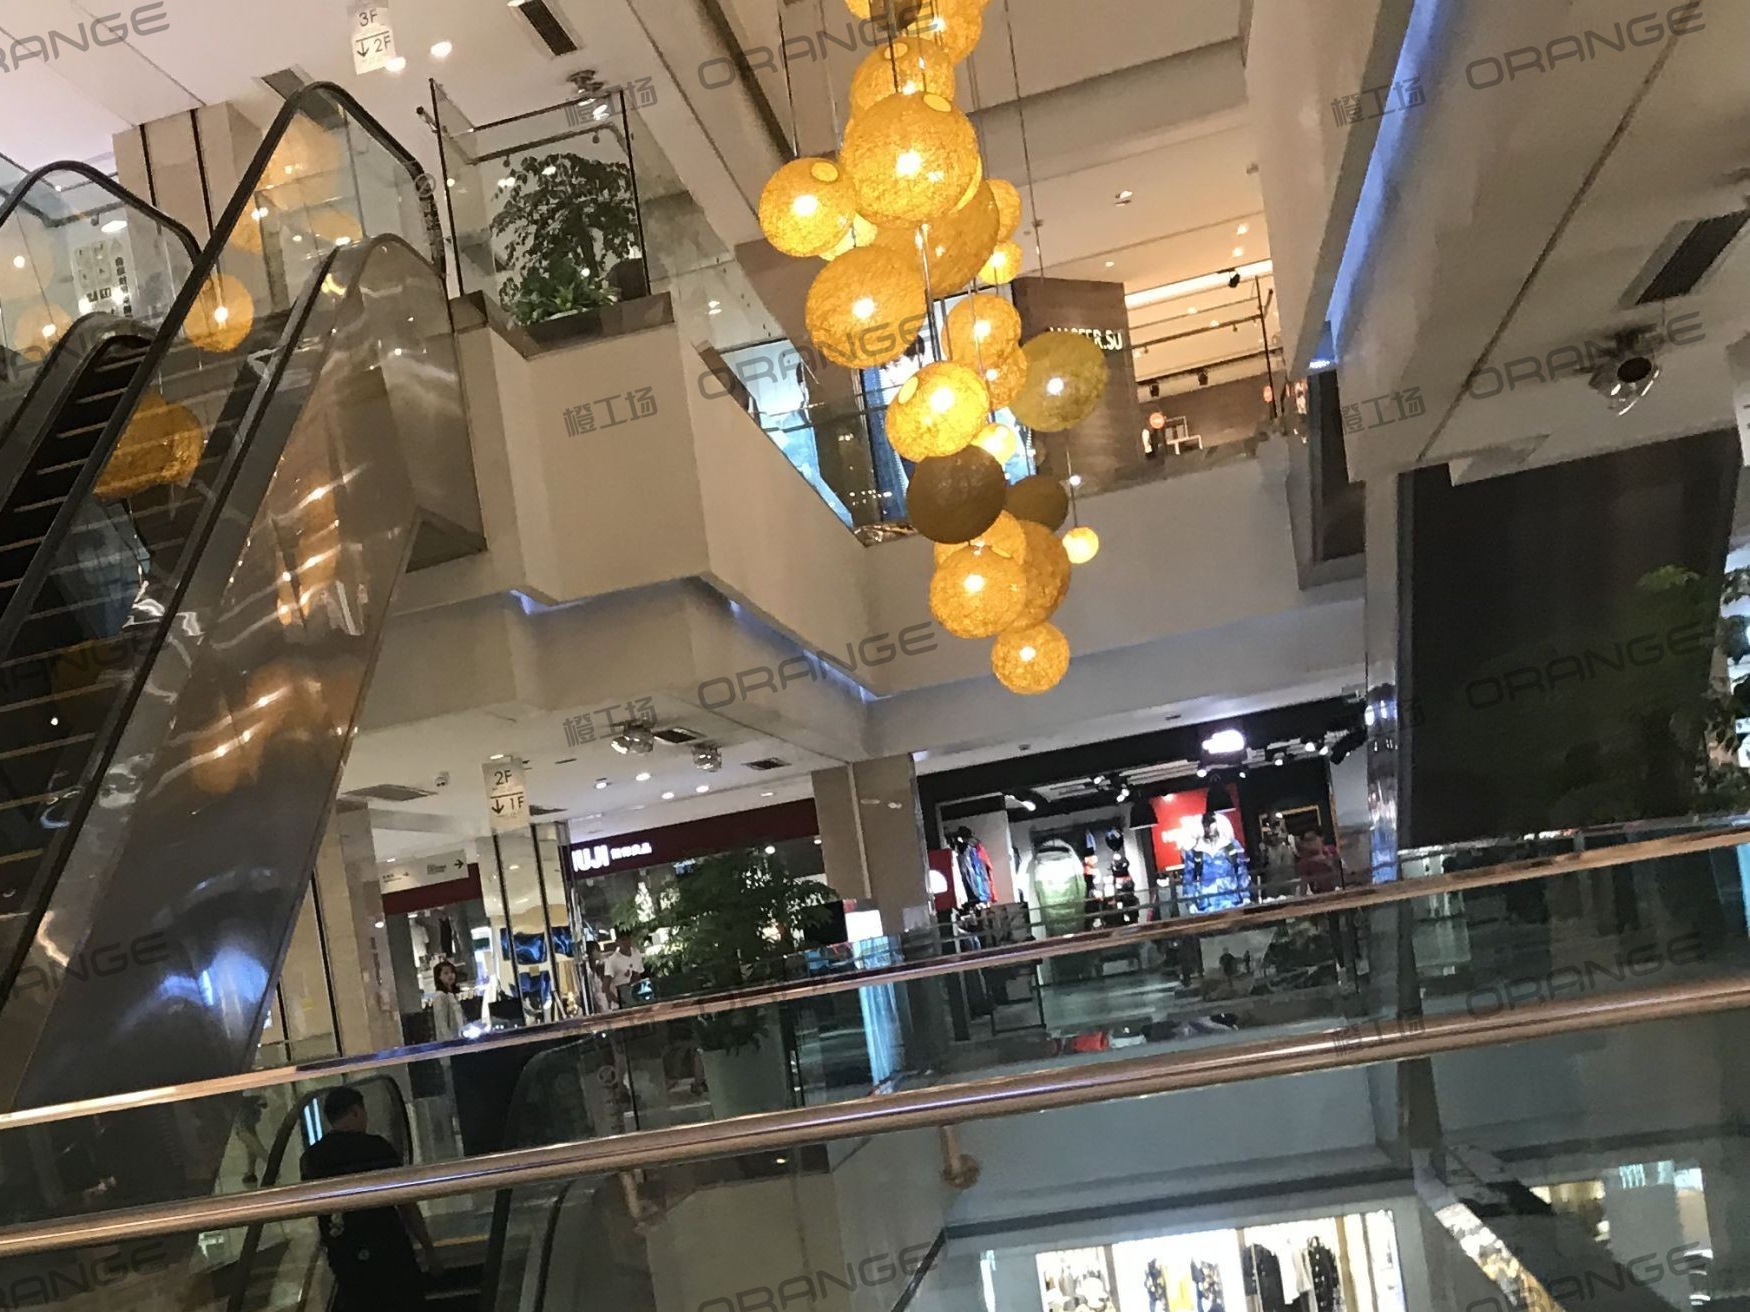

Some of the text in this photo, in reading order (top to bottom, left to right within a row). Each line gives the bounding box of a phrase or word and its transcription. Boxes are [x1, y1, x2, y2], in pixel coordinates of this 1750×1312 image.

[359, 8, 378, 27] 3F
[374, 35, 391, 53] 2F
[494, 770, 512, 785] 2F
[511, 796, 524, 810] 1F
